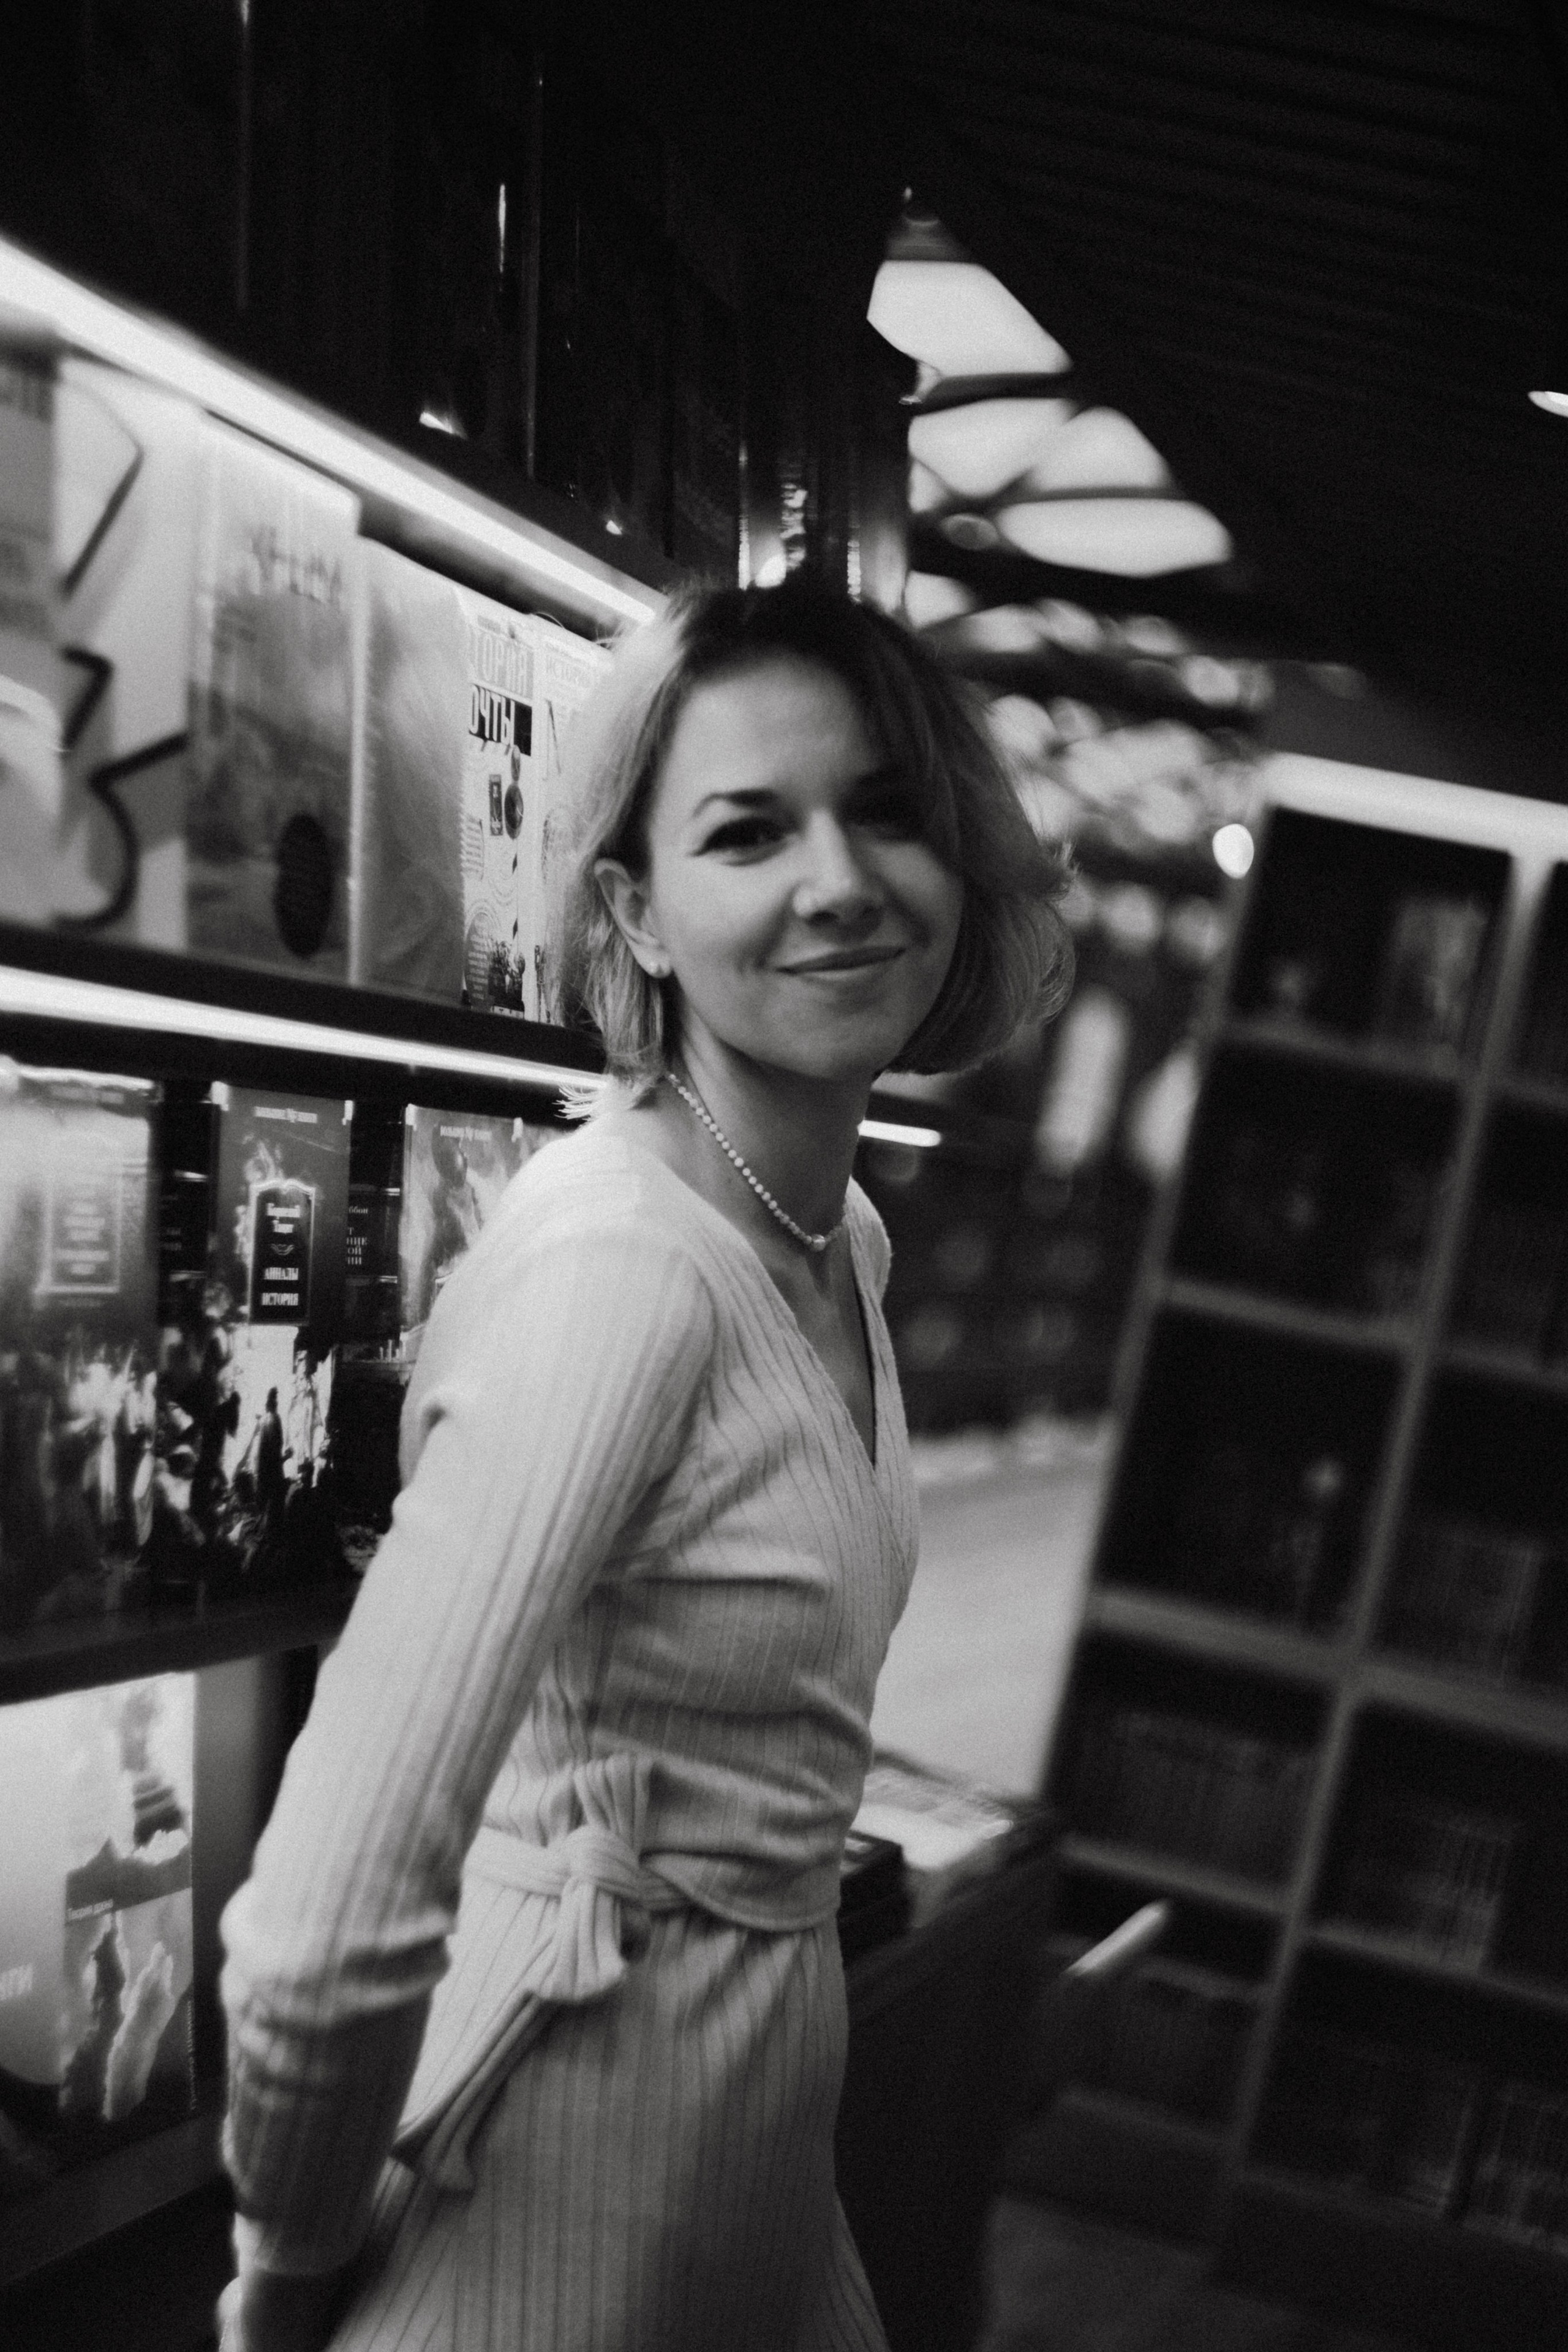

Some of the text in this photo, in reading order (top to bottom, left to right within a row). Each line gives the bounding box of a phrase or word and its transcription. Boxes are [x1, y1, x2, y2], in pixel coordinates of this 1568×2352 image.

[470, 685, 515, 747] ОЧТЫ
[263, 1267, 299, 1281] АННАЛЫ
[262, 1292, 299, 1306] ИСТОРИЯ
